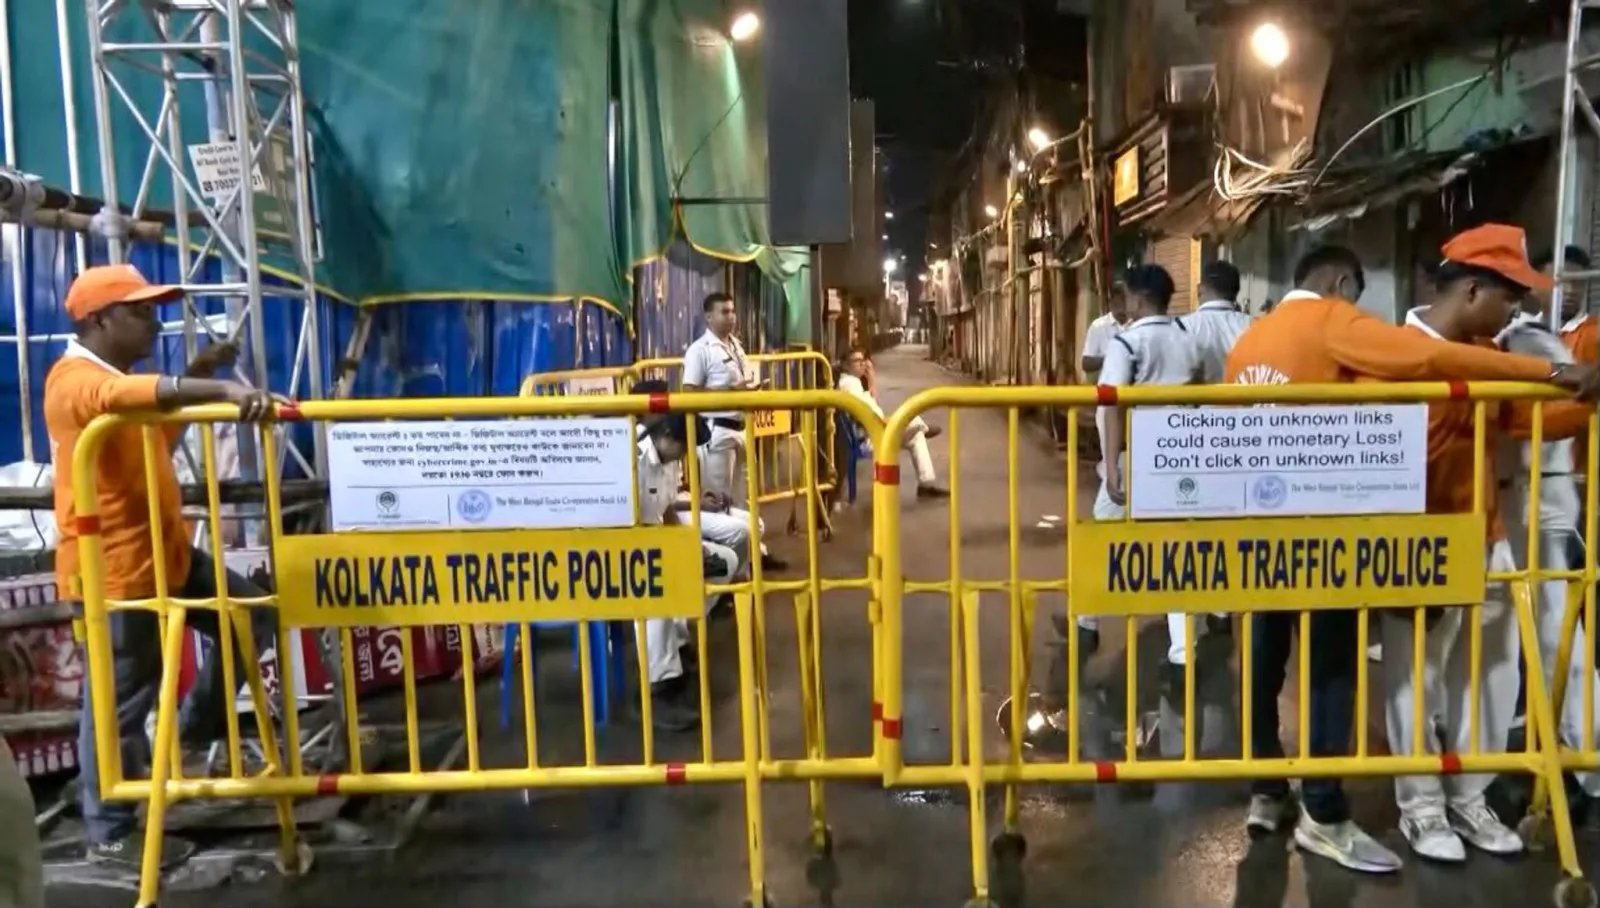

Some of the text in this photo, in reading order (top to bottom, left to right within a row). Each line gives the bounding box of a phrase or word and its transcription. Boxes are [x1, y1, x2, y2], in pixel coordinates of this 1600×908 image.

[1167, 410, 1393, 431] Clicking on unknown links
[1157, 431, 1402, 450] could cause monetary Loss!
[1154, 450, 1404, 469] Don't click on unknown links!
[1108, 536, 1449, 593] KOLKATA TRAFFIC POLICE
[315, 548, 664, 607] KOLKATA TRAFFIC POLICE
